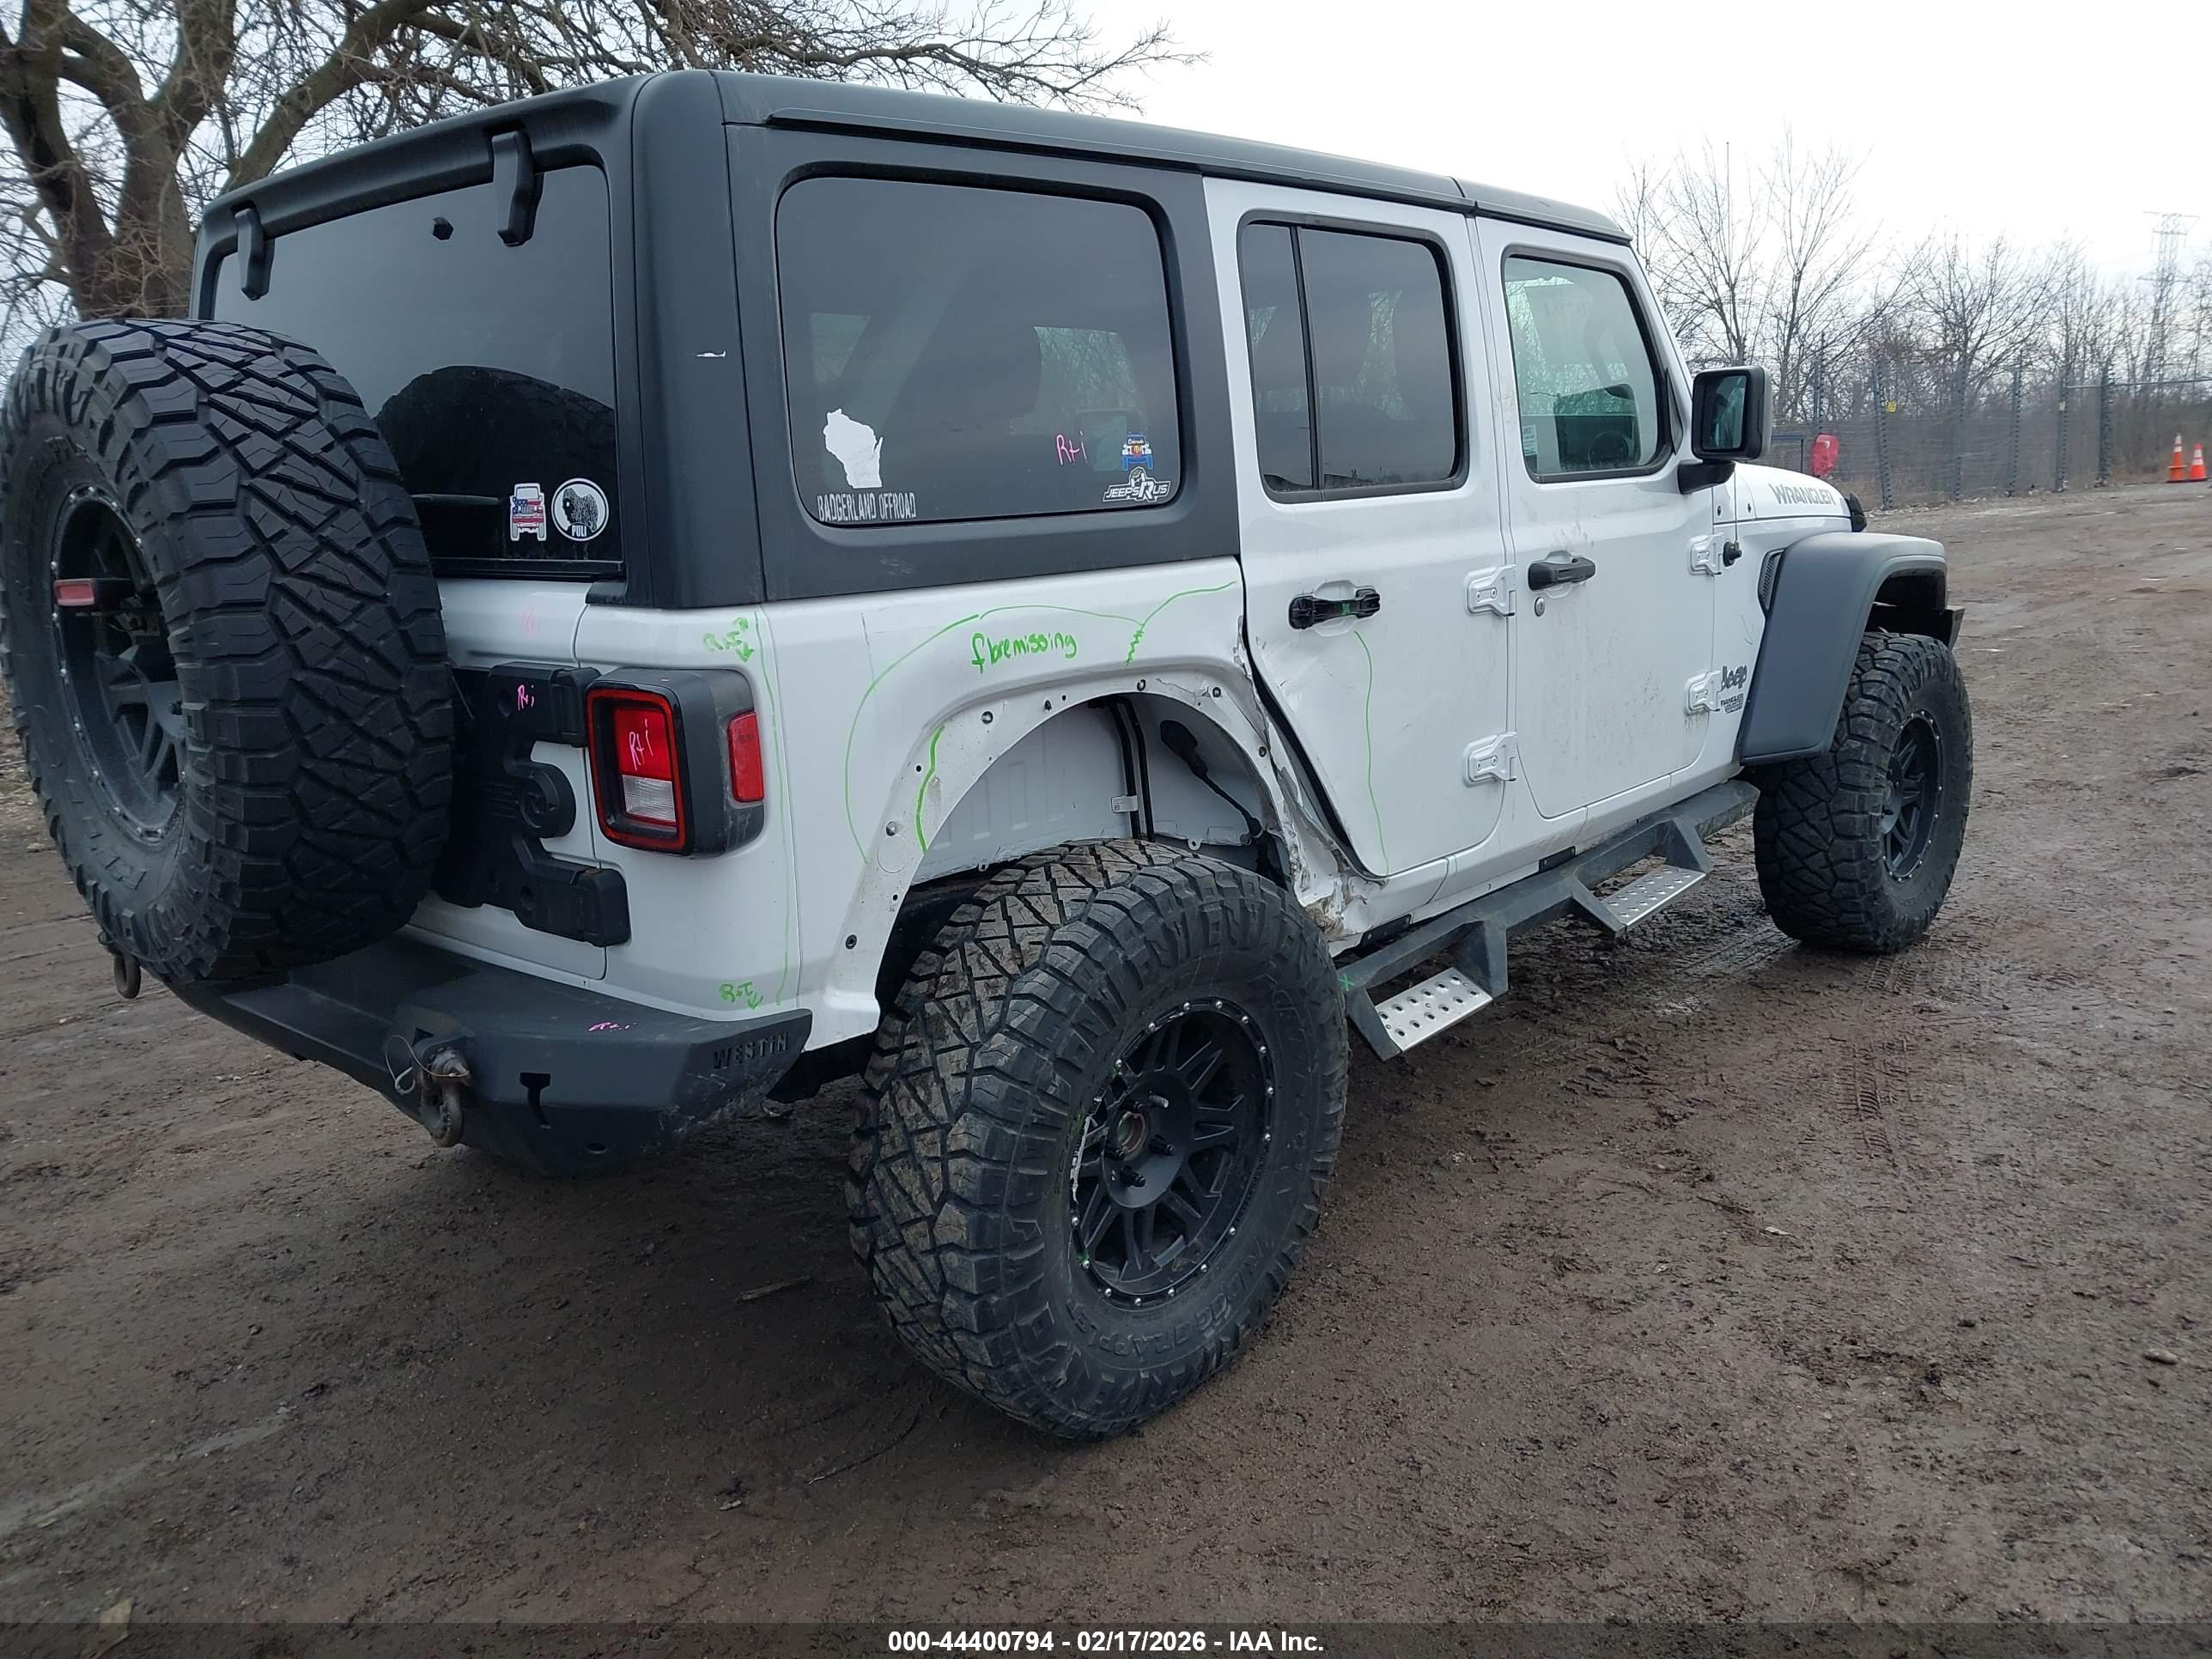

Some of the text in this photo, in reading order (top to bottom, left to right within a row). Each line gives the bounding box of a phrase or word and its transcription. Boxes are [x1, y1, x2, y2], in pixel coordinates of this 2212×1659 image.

[817, 492, 916, 522] BADGERLAND OFFROAD
[1767, 483, 1836, 506] WRANGLER
[571, 525, 587, 538] PULI
[1720, 665, 1747, 692] Jeep
